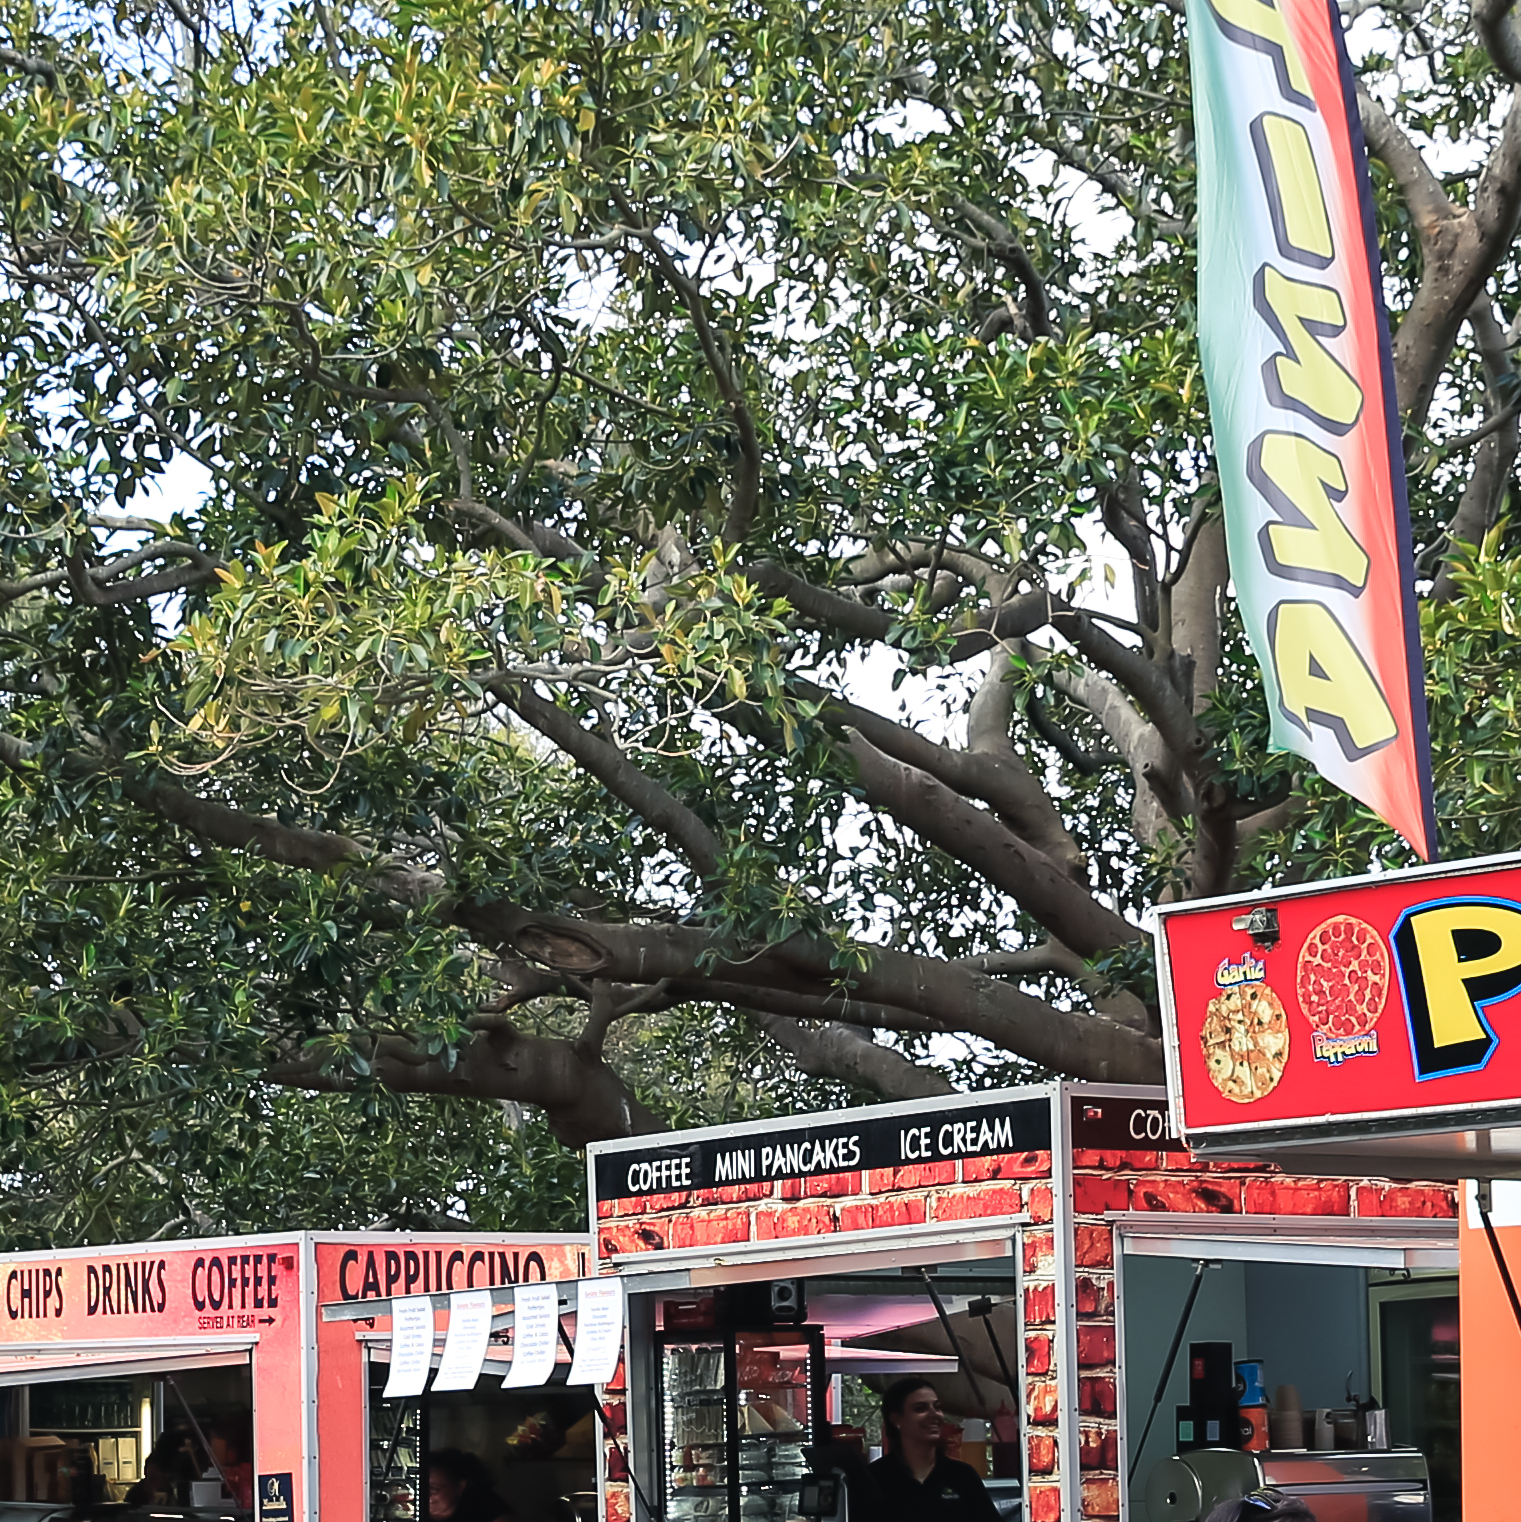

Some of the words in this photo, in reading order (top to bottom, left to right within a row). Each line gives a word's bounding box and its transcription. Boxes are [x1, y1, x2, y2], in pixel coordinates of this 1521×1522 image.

[1215, 952, 1265, 987] Garlic
[1312, 1031, 1379, 1066] Pepperoni
[627, 1157, 692, 1192] COFFEE
[714, 1148, 755, 1182] MINI
[762, 1135, 860, 1176] PANCAKES
[900, 1126, 932, 1160] ICE
[938, 1116, 1014, 1156] CREAM
[6, 1266, 63, 1320] CHIPS
[86, 1259, 167, 1317] DRINKS
[191, 1252, 279, 1312] COFFEE
[339, 1249, 547, 1301] CAPPUCCINO
[197, 1316, 224, 1330] SERVED
[226, 1315, 235, 1329] AT
[237, 1314, 256, 1329] REAR
